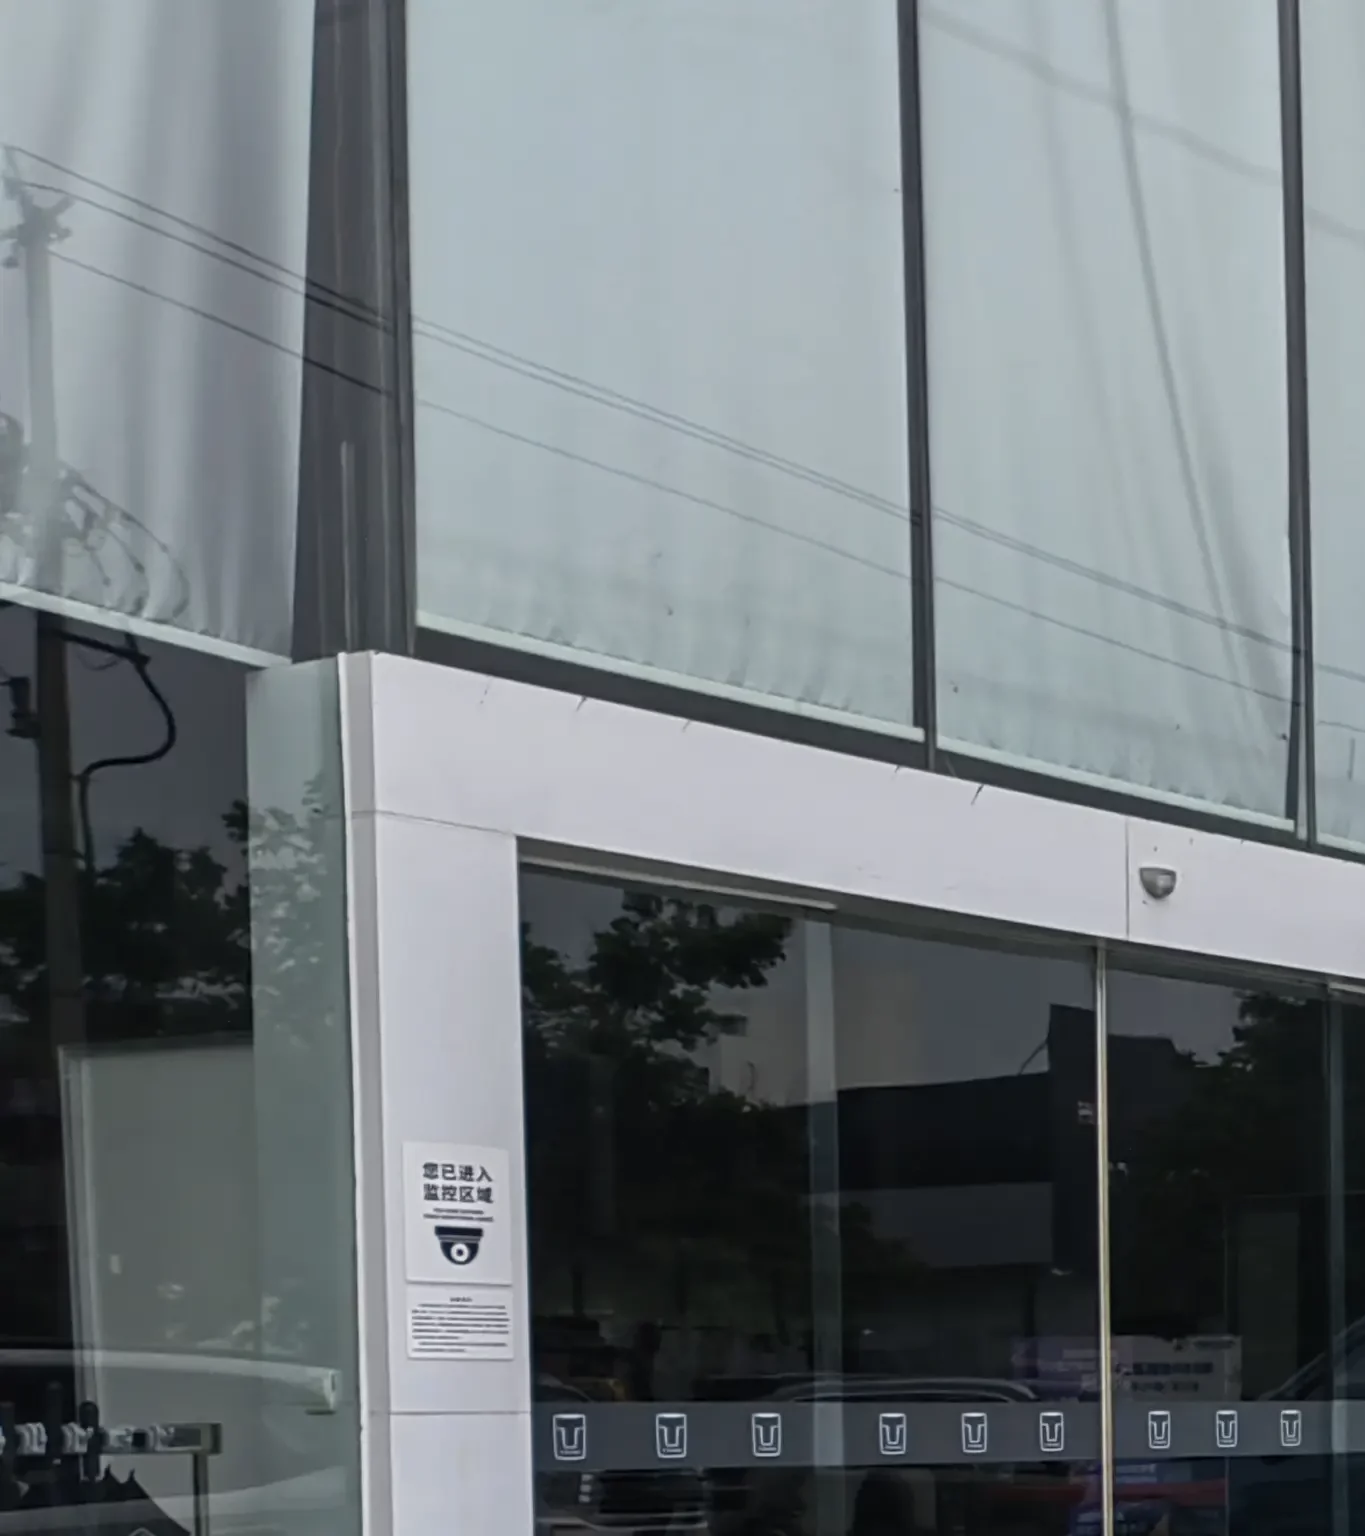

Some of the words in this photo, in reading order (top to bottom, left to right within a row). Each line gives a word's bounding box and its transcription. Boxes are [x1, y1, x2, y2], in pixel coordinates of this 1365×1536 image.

[423, 1162, 493, 1182] 您已进入
[424, 1183, 493, 1203] 监控区域
